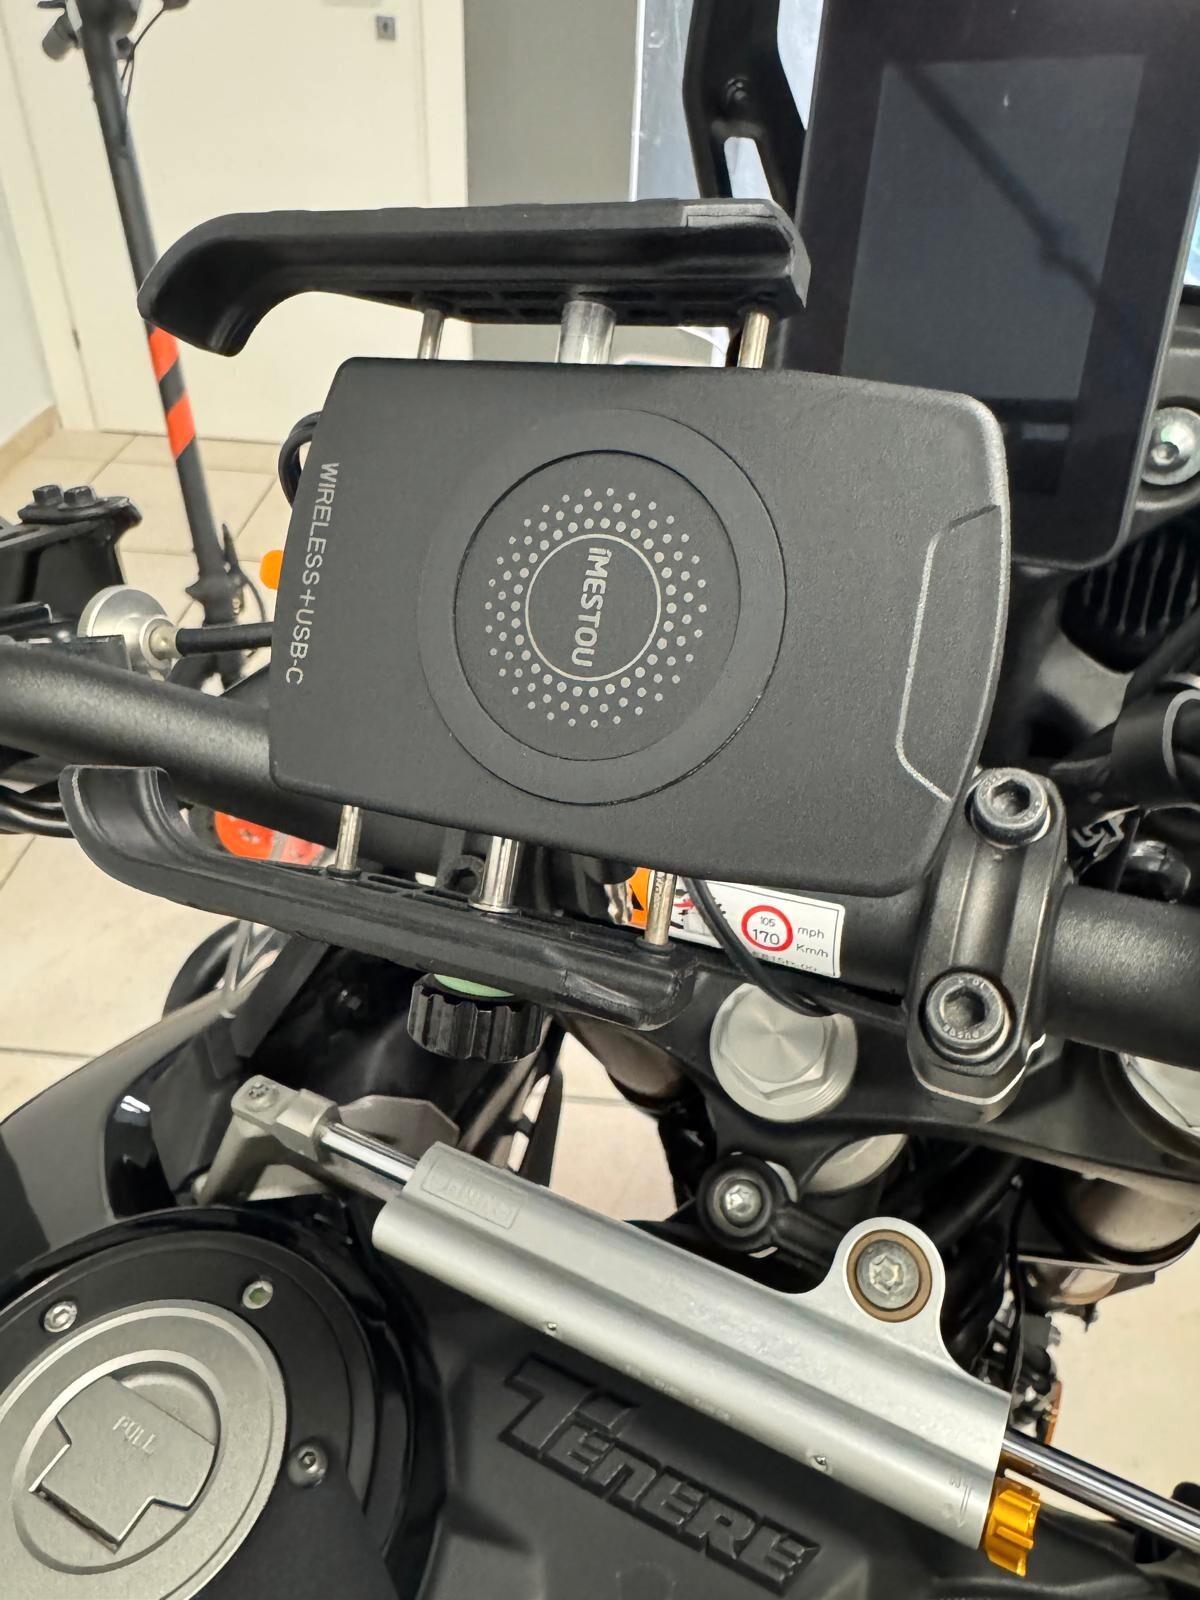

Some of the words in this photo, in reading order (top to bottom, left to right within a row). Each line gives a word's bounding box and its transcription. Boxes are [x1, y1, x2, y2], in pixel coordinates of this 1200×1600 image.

[760, 915, 776, 928] 105
[797, 926, 825, 940] mph
[752, 928, 780, 946] 170
[796, 943, 829, 959] Km/h
[112, 1415, 157, 1457] PULL
